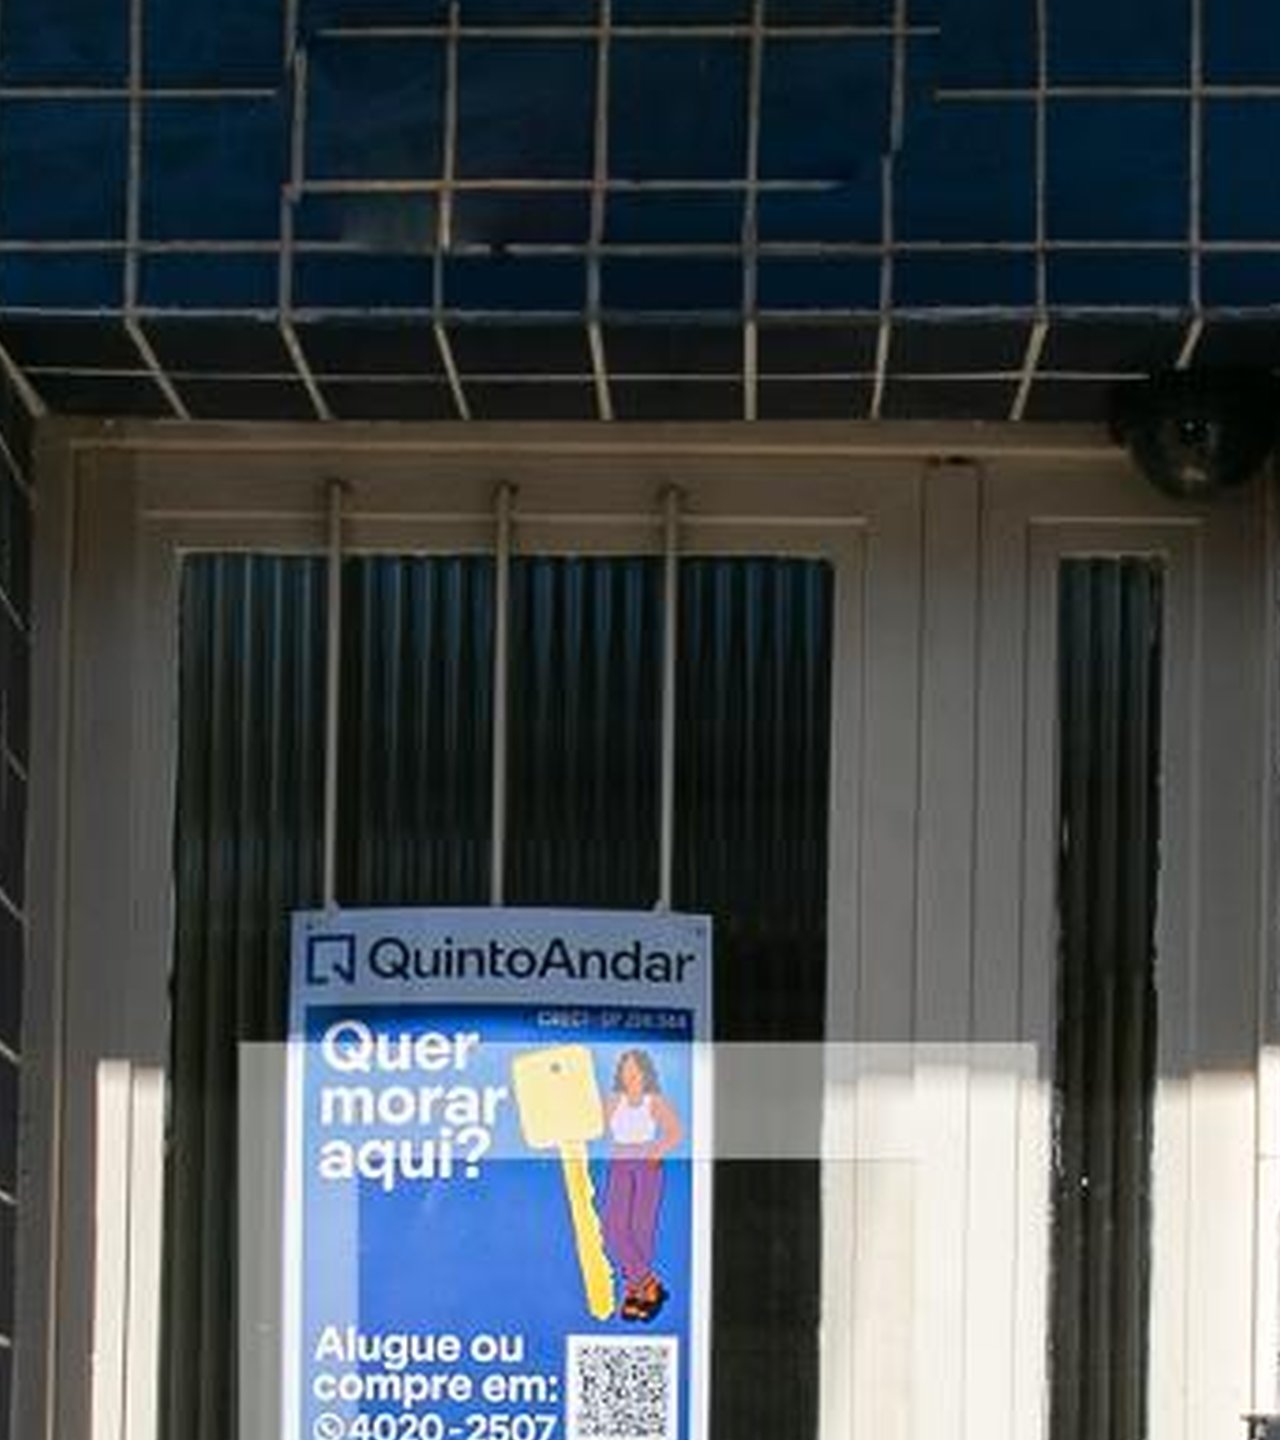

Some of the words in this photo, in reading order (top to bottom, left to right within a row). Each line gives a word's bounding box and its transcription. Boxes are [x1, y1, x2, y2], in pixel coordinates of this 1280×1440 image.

[368, 936, 695, 984] QuintoAndar
[322, 1020, 478, 1073] Quer
[320, 1087, 508, 1128] morar
[319, 1127, 492, 1191] aqui?
[316, 1328, 462, 1370] Alugue
[472, 1335, 523, 1363] ou
[314, 1373, 471, 1408] compre
[482, 1374, 559, 1402] em:
